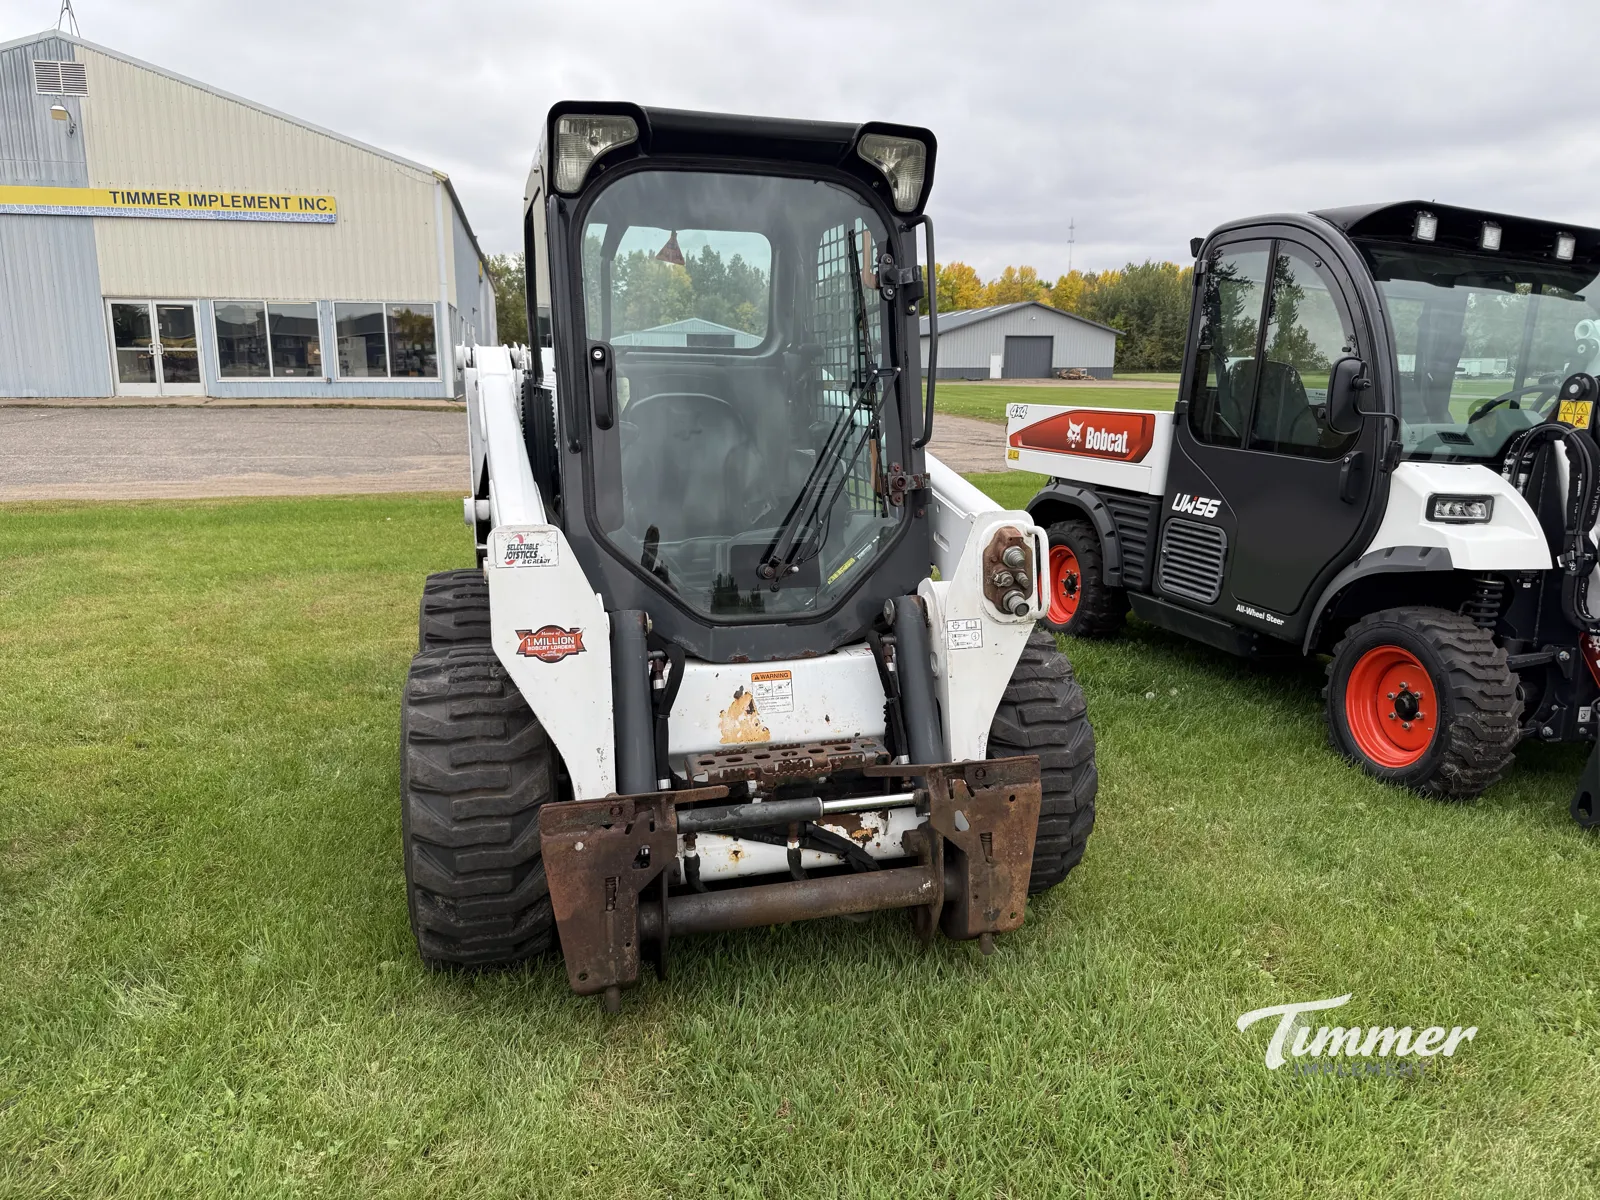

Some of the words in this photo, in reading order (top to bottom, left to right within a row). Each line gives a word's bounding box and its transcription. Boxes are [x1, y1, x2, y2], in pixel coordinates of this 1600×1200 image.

[109, 191, 181, 206] TIMMER
[188, 194, 291, 210] IMPLEMENT
[298, 197, 333, 211] INC.
[1010, 405, 1028, 419] 4x4
[1085, 426, 1129, 453] Bobcat
[1172, 492, 1222, 518] UW56
[504, 551, 538, 559] JOYSTICKS
[1235, 603, 1265, 620] All-Wheel
[1266, 613, 1285, 626] Steer
[527, 637, 532, 646] 1
[533, 636, 575, 646] MILLION
[760, 672, 789, 680] WARNING
